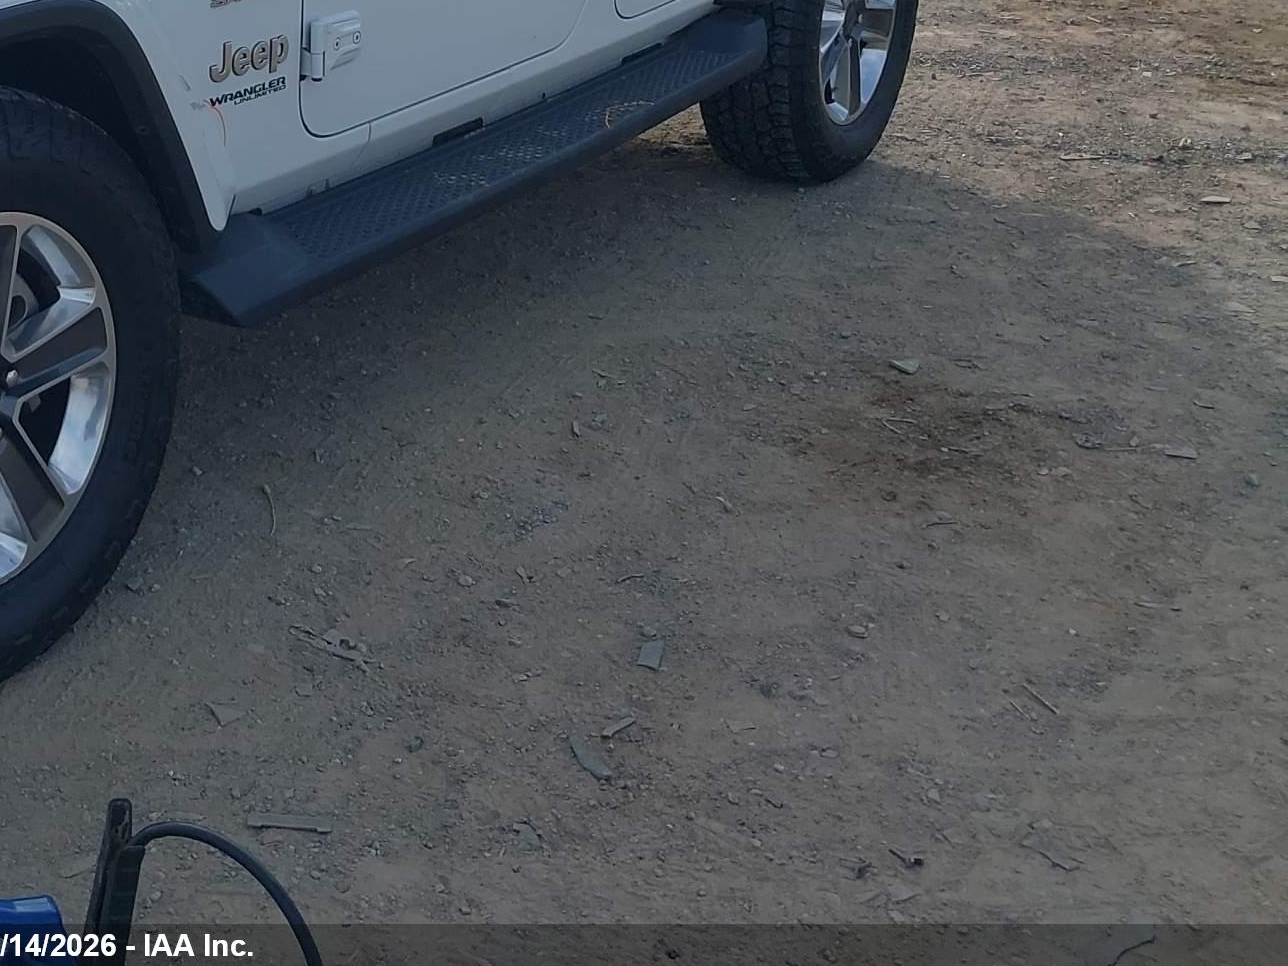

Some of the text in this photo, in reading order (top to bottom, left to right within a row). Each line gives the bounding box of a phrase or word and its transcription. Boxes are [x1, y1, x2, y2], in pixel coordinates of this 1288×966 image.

[209, 34, 289, 83] Jeep
[209, 76, 286, 107] WRANGLER
[233, 84, 287, 106] UNLIMITED
